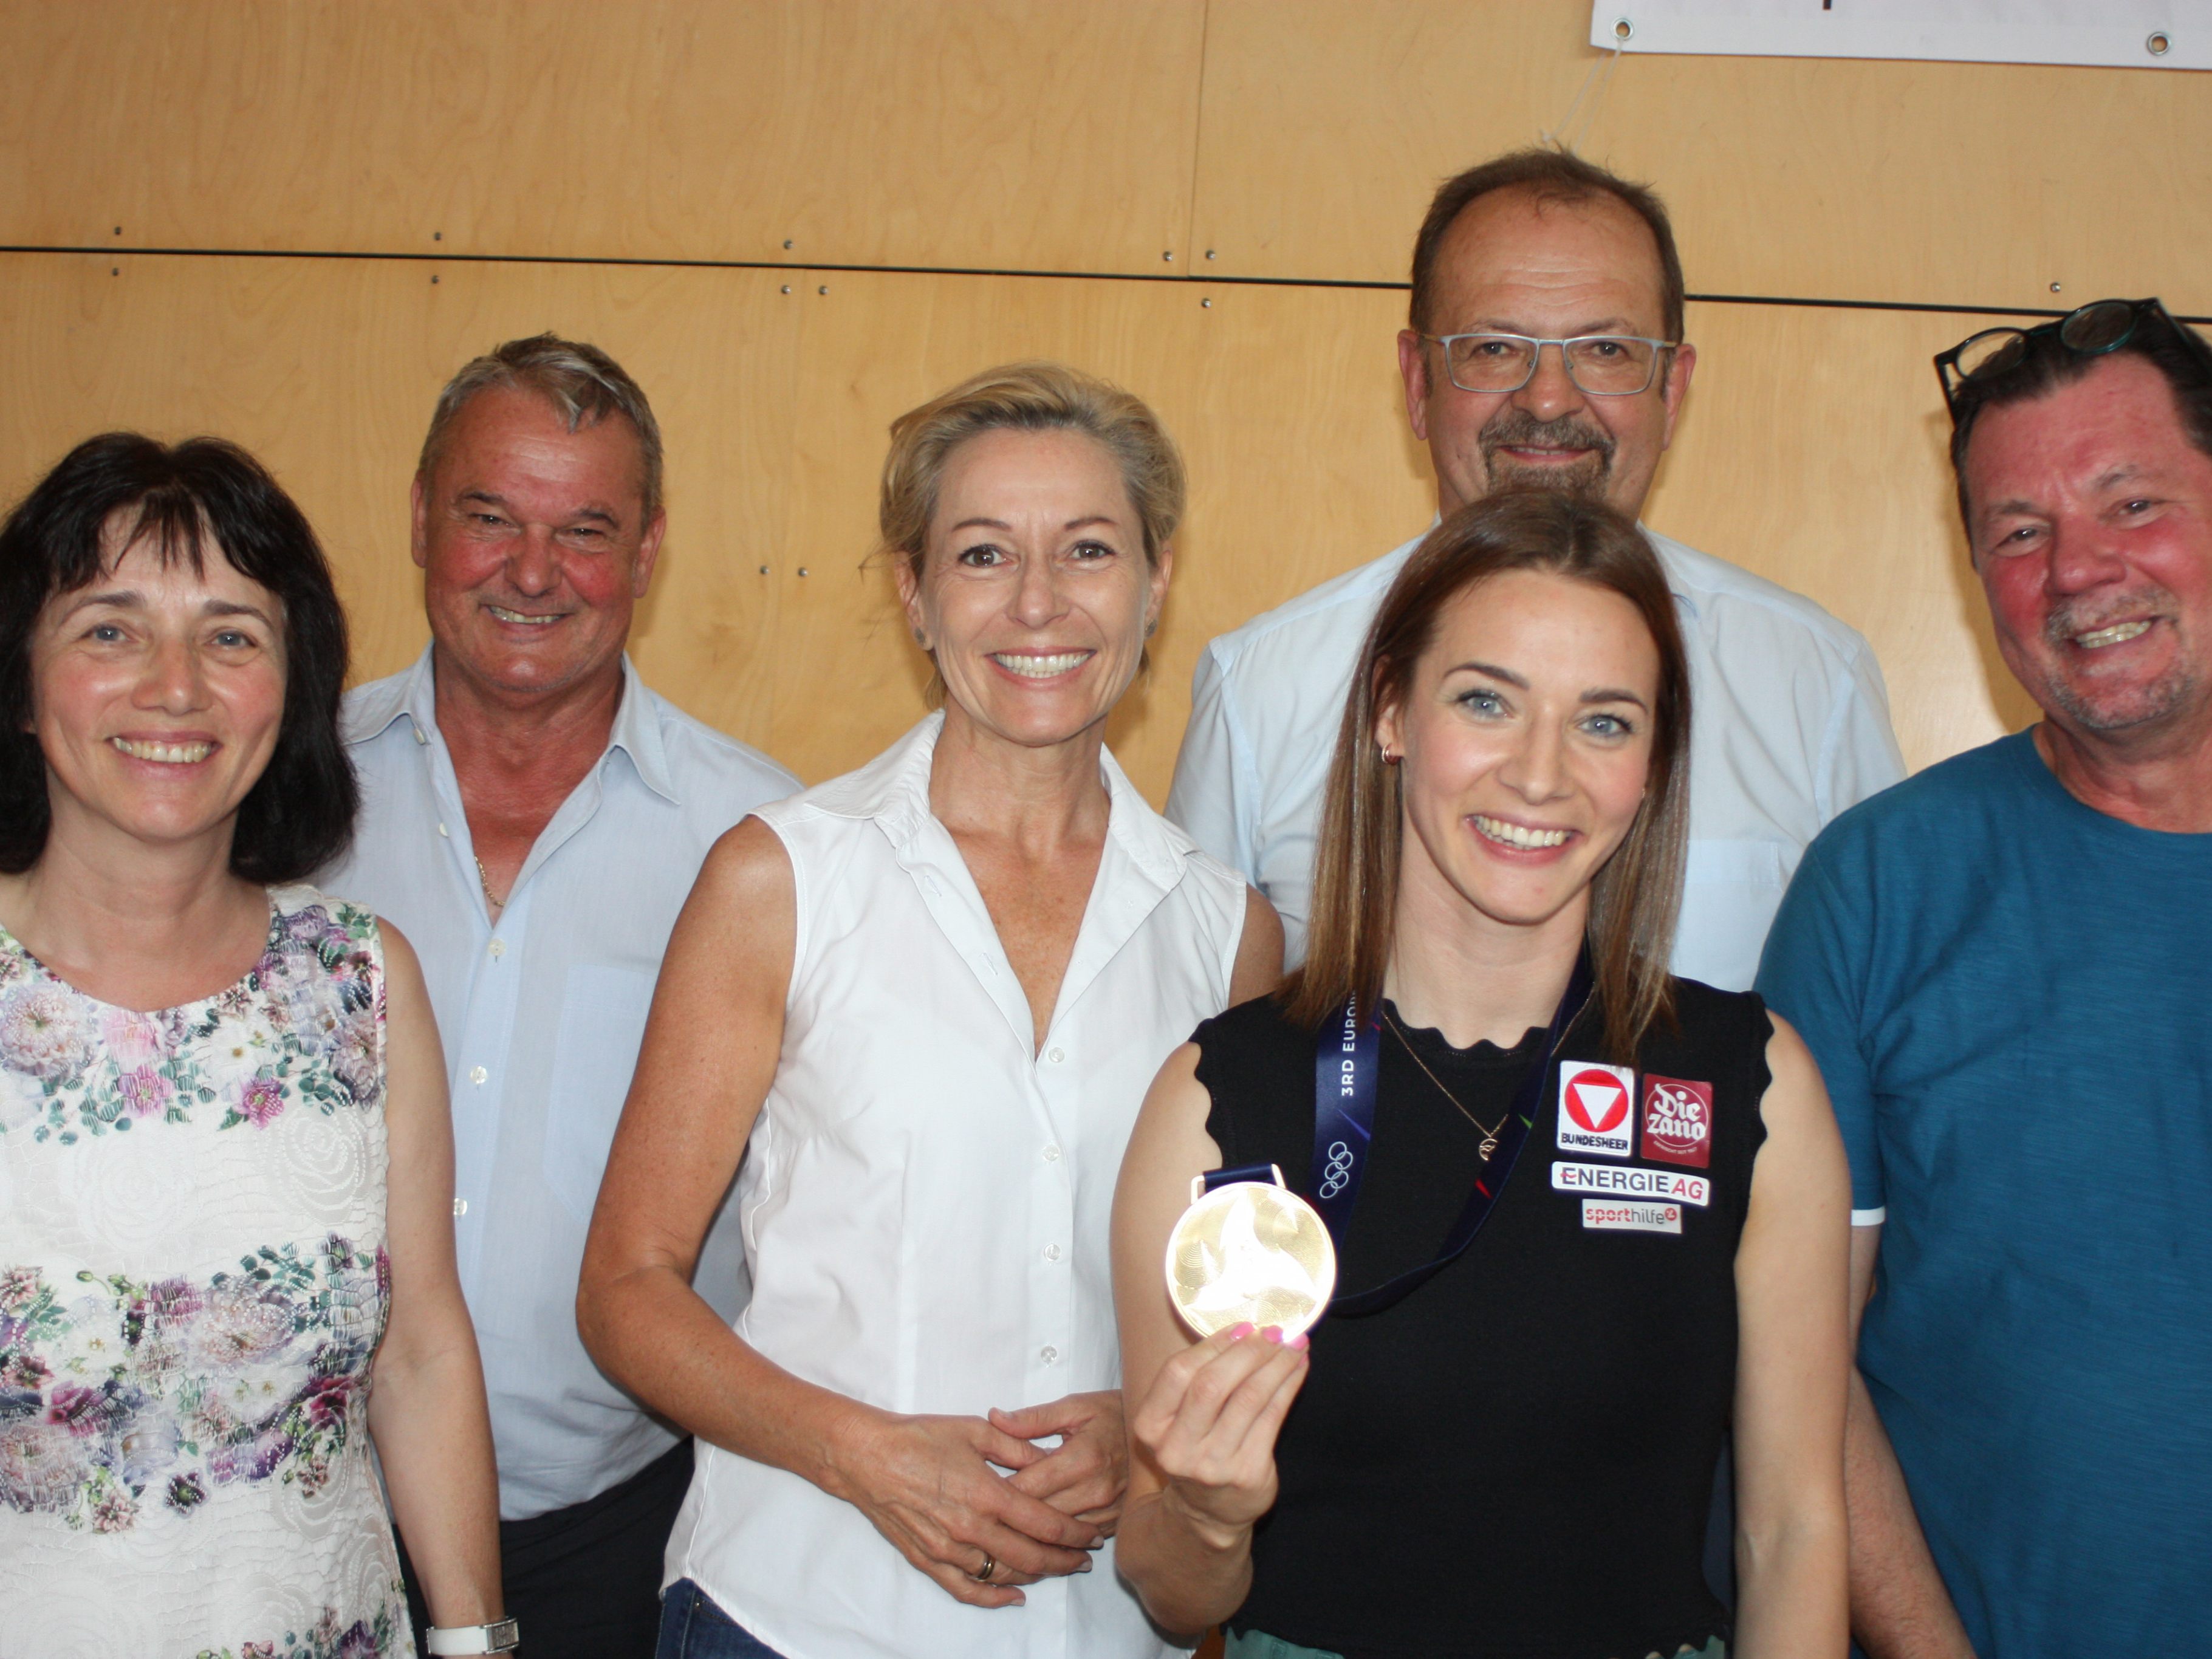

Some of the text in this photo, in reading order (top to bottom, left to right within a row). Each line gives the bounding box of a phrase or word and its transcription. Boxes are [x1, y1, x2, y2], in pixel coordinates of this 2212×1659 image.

[1341, 1059, 1354, 1096] 3RD
[1654, 1083, 1700, 1121] Die
[1561, 1132, 1628, 1150] BUNDESHEER
[1586, 1207, 1665, 1224] sporthilfe
